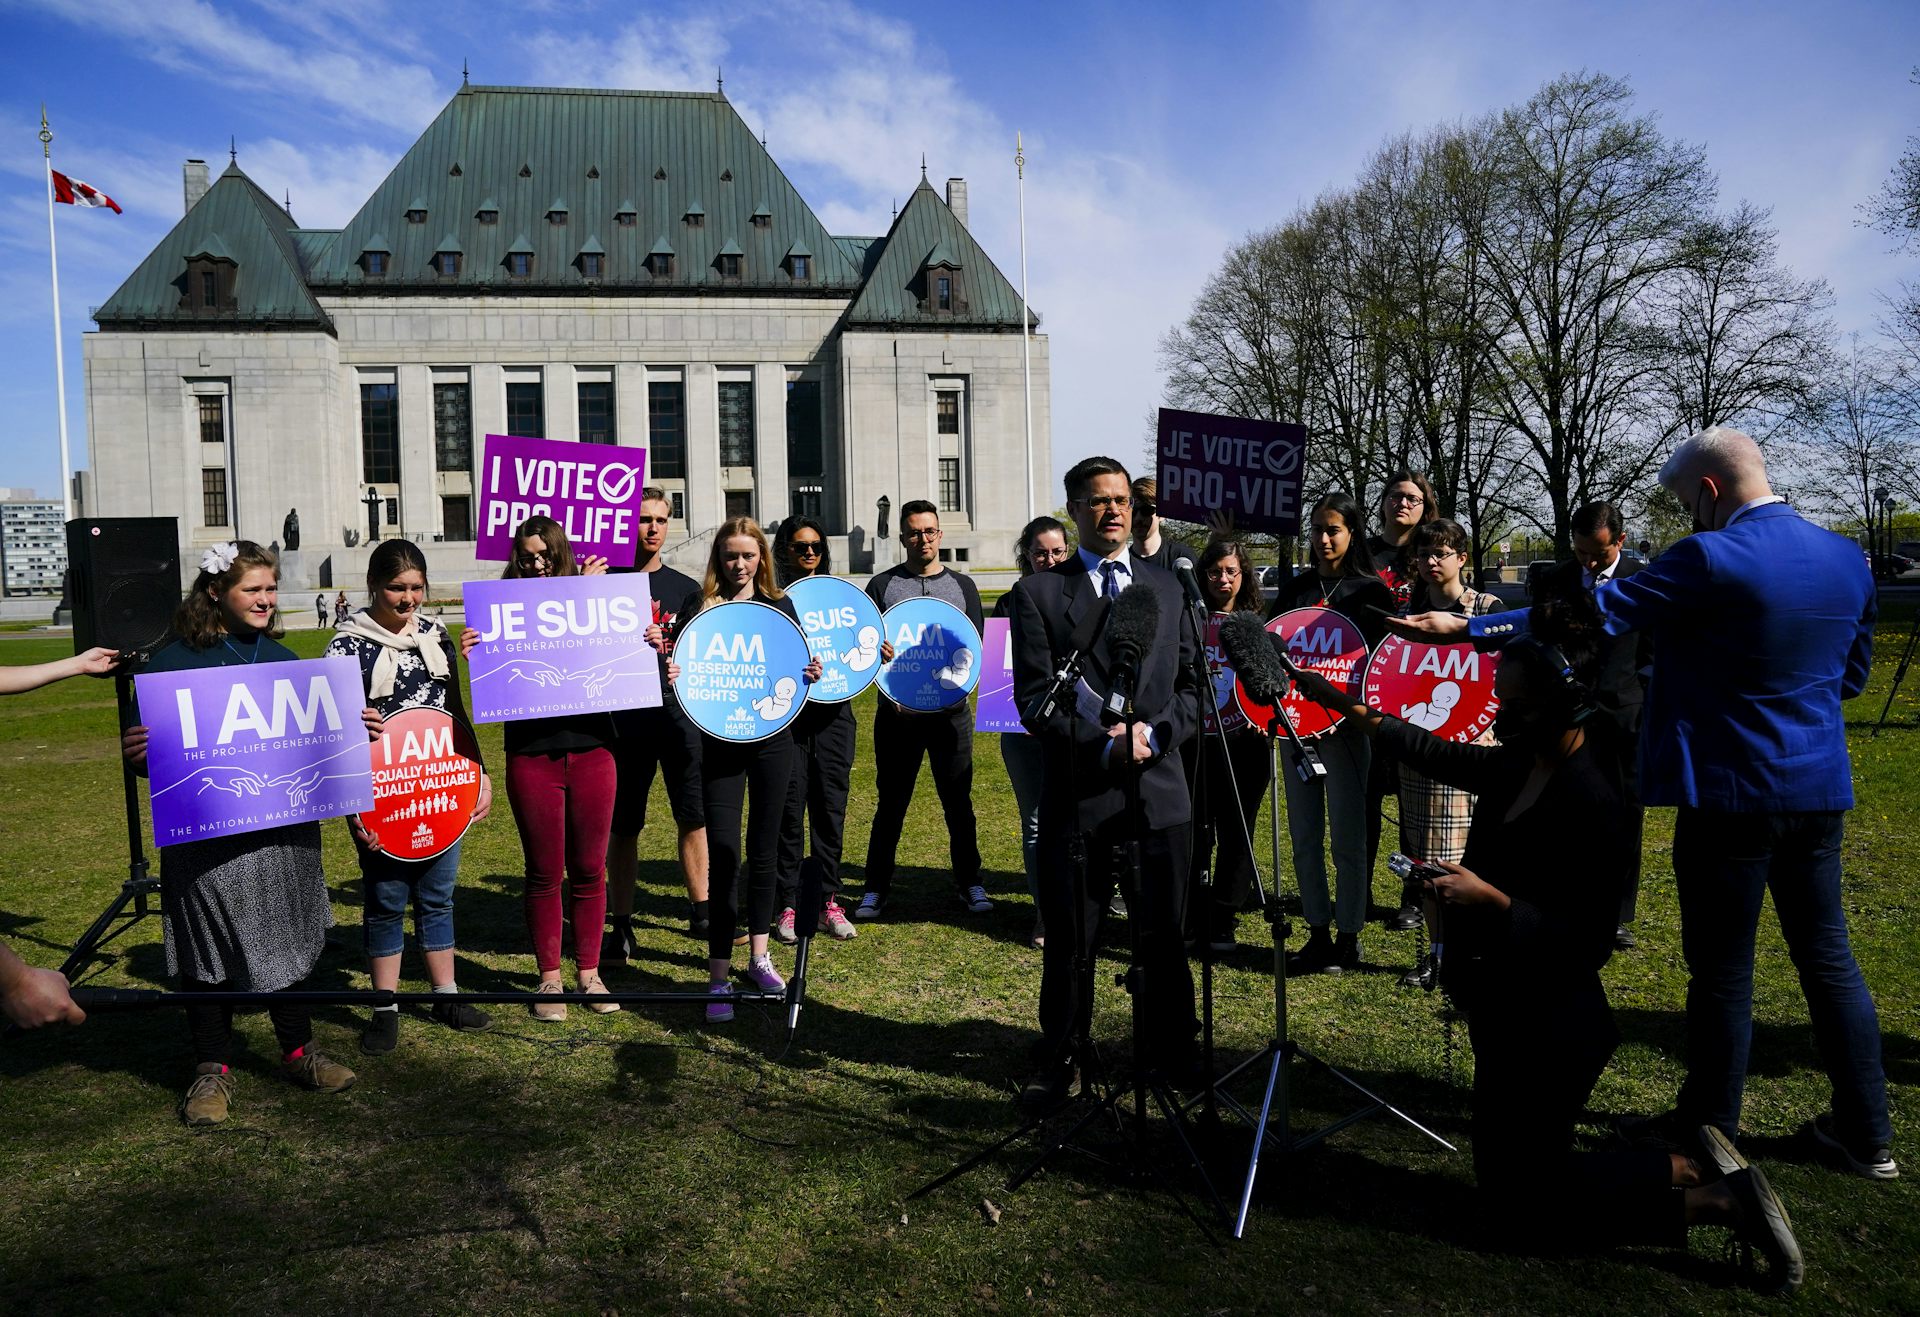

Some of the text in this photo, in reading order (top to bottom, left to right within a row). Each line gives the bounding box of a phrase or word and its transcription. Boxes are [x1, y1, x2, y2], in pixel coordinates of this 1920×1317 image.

[1163, 430, 1263, 470] JE VOTE
[490, 455, 597, 501] I VOTE
[1162, 463, 1297, 519] PRO-VIE
[481, 596, 639, 643] JE SUIS
[803, 606, 858, 632] SUIS
[485, 634, 639, 655] LA GÉNÉRATION PRO-VIE
[688, 630, 697, 660] I
[703, 632, 766, 663] AM
[808, 635, 832, 650] TRE
[894, 623, 945, 647] AM
[1288, 625, 1342, 655] AM
[896, 647, 944, 660] HUMAN
[1306, 655, 1357, 671] HUMAN
[1399, 644, 1412, 674] I
[1413, 647, 1480, 682] AM
[688, 661, 767, 676] DESERVING
[687, 674, 764, 690] OF HUMAN
[687, 687, 739, 702] RIGHTS
[174, 675, 343, 749] I AM
[481, 707, 524, 718] MARCHE
[529, 700, 585, 713] NATIONALE
[590, 698, 618, 708] POUR
[622, 697, 634, 705] LA
[725, 722, 756, 730] MARCH
[985, 720, 1001, 728] THE
[184, 733, 344, 762] THE PRO-LIFE GENERATION
[382, 726, 456, 766] I AM
[425, 758, 470, 777] HUMAN
[373, 771, 476, 800] QUALLY VALUABLE
[170, 798, 363, 837] THE NATIONAL MARCH FOR LIFE
[411, 834, 434, 845] MARCH
